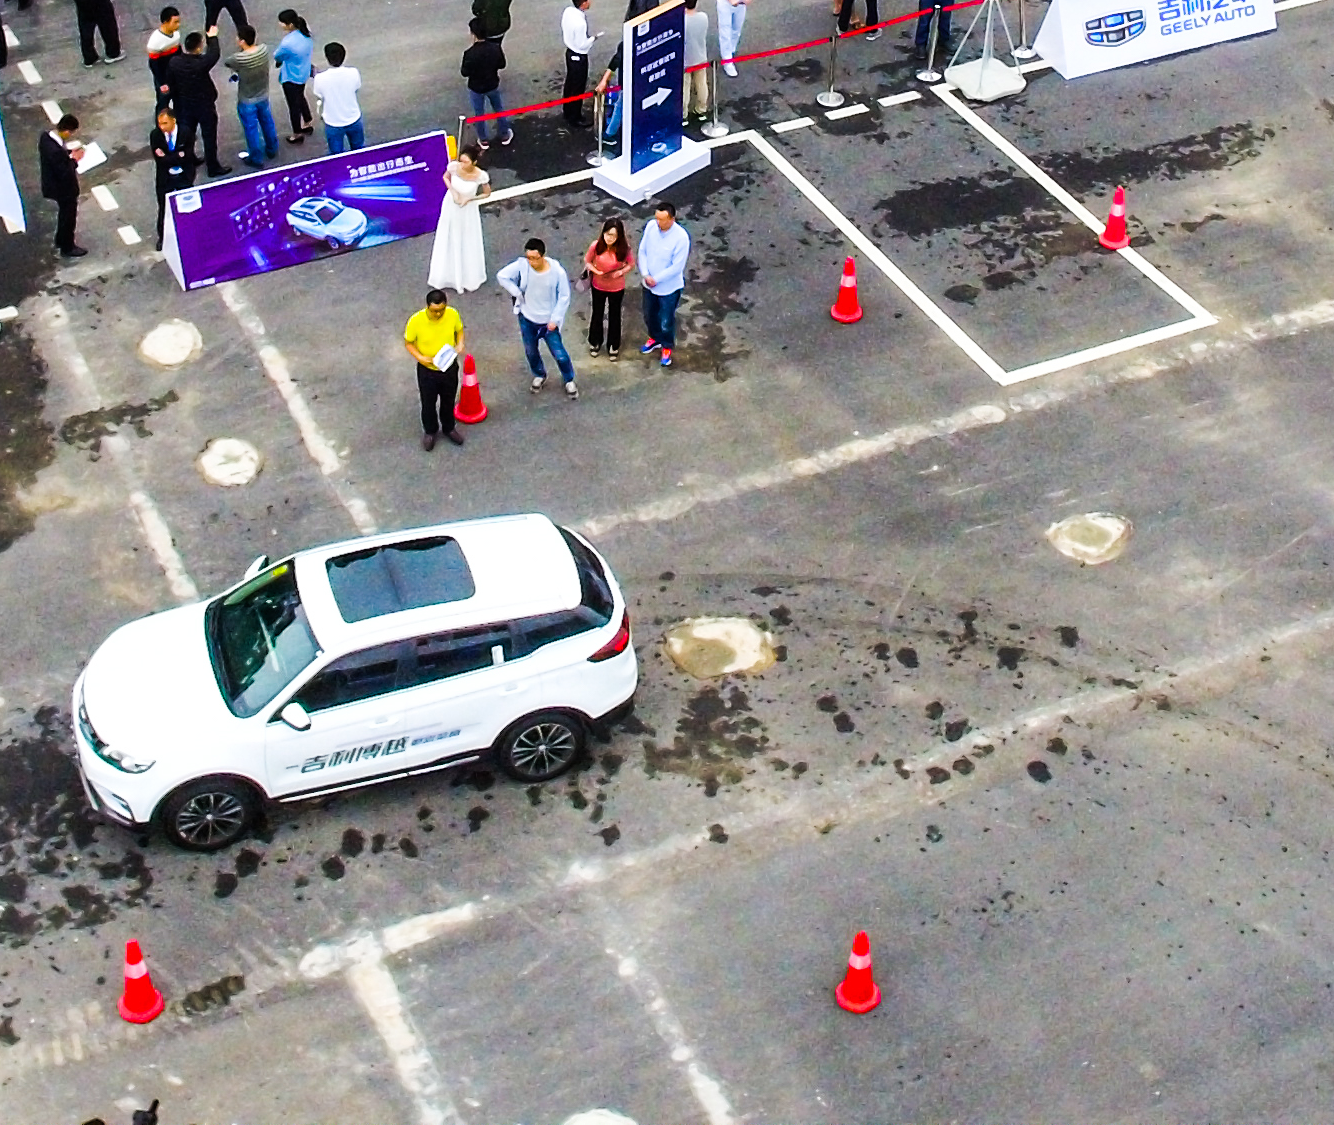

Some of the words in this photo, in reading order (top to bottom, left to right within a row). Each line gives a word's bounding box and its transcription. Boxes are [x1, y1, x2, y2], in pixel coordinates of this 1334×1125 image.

[1161, 15, 1211, 36] GEELY
[1214, 5, 1256, 24] AUTO
[301, 736, 409, 773] 吉利博越
